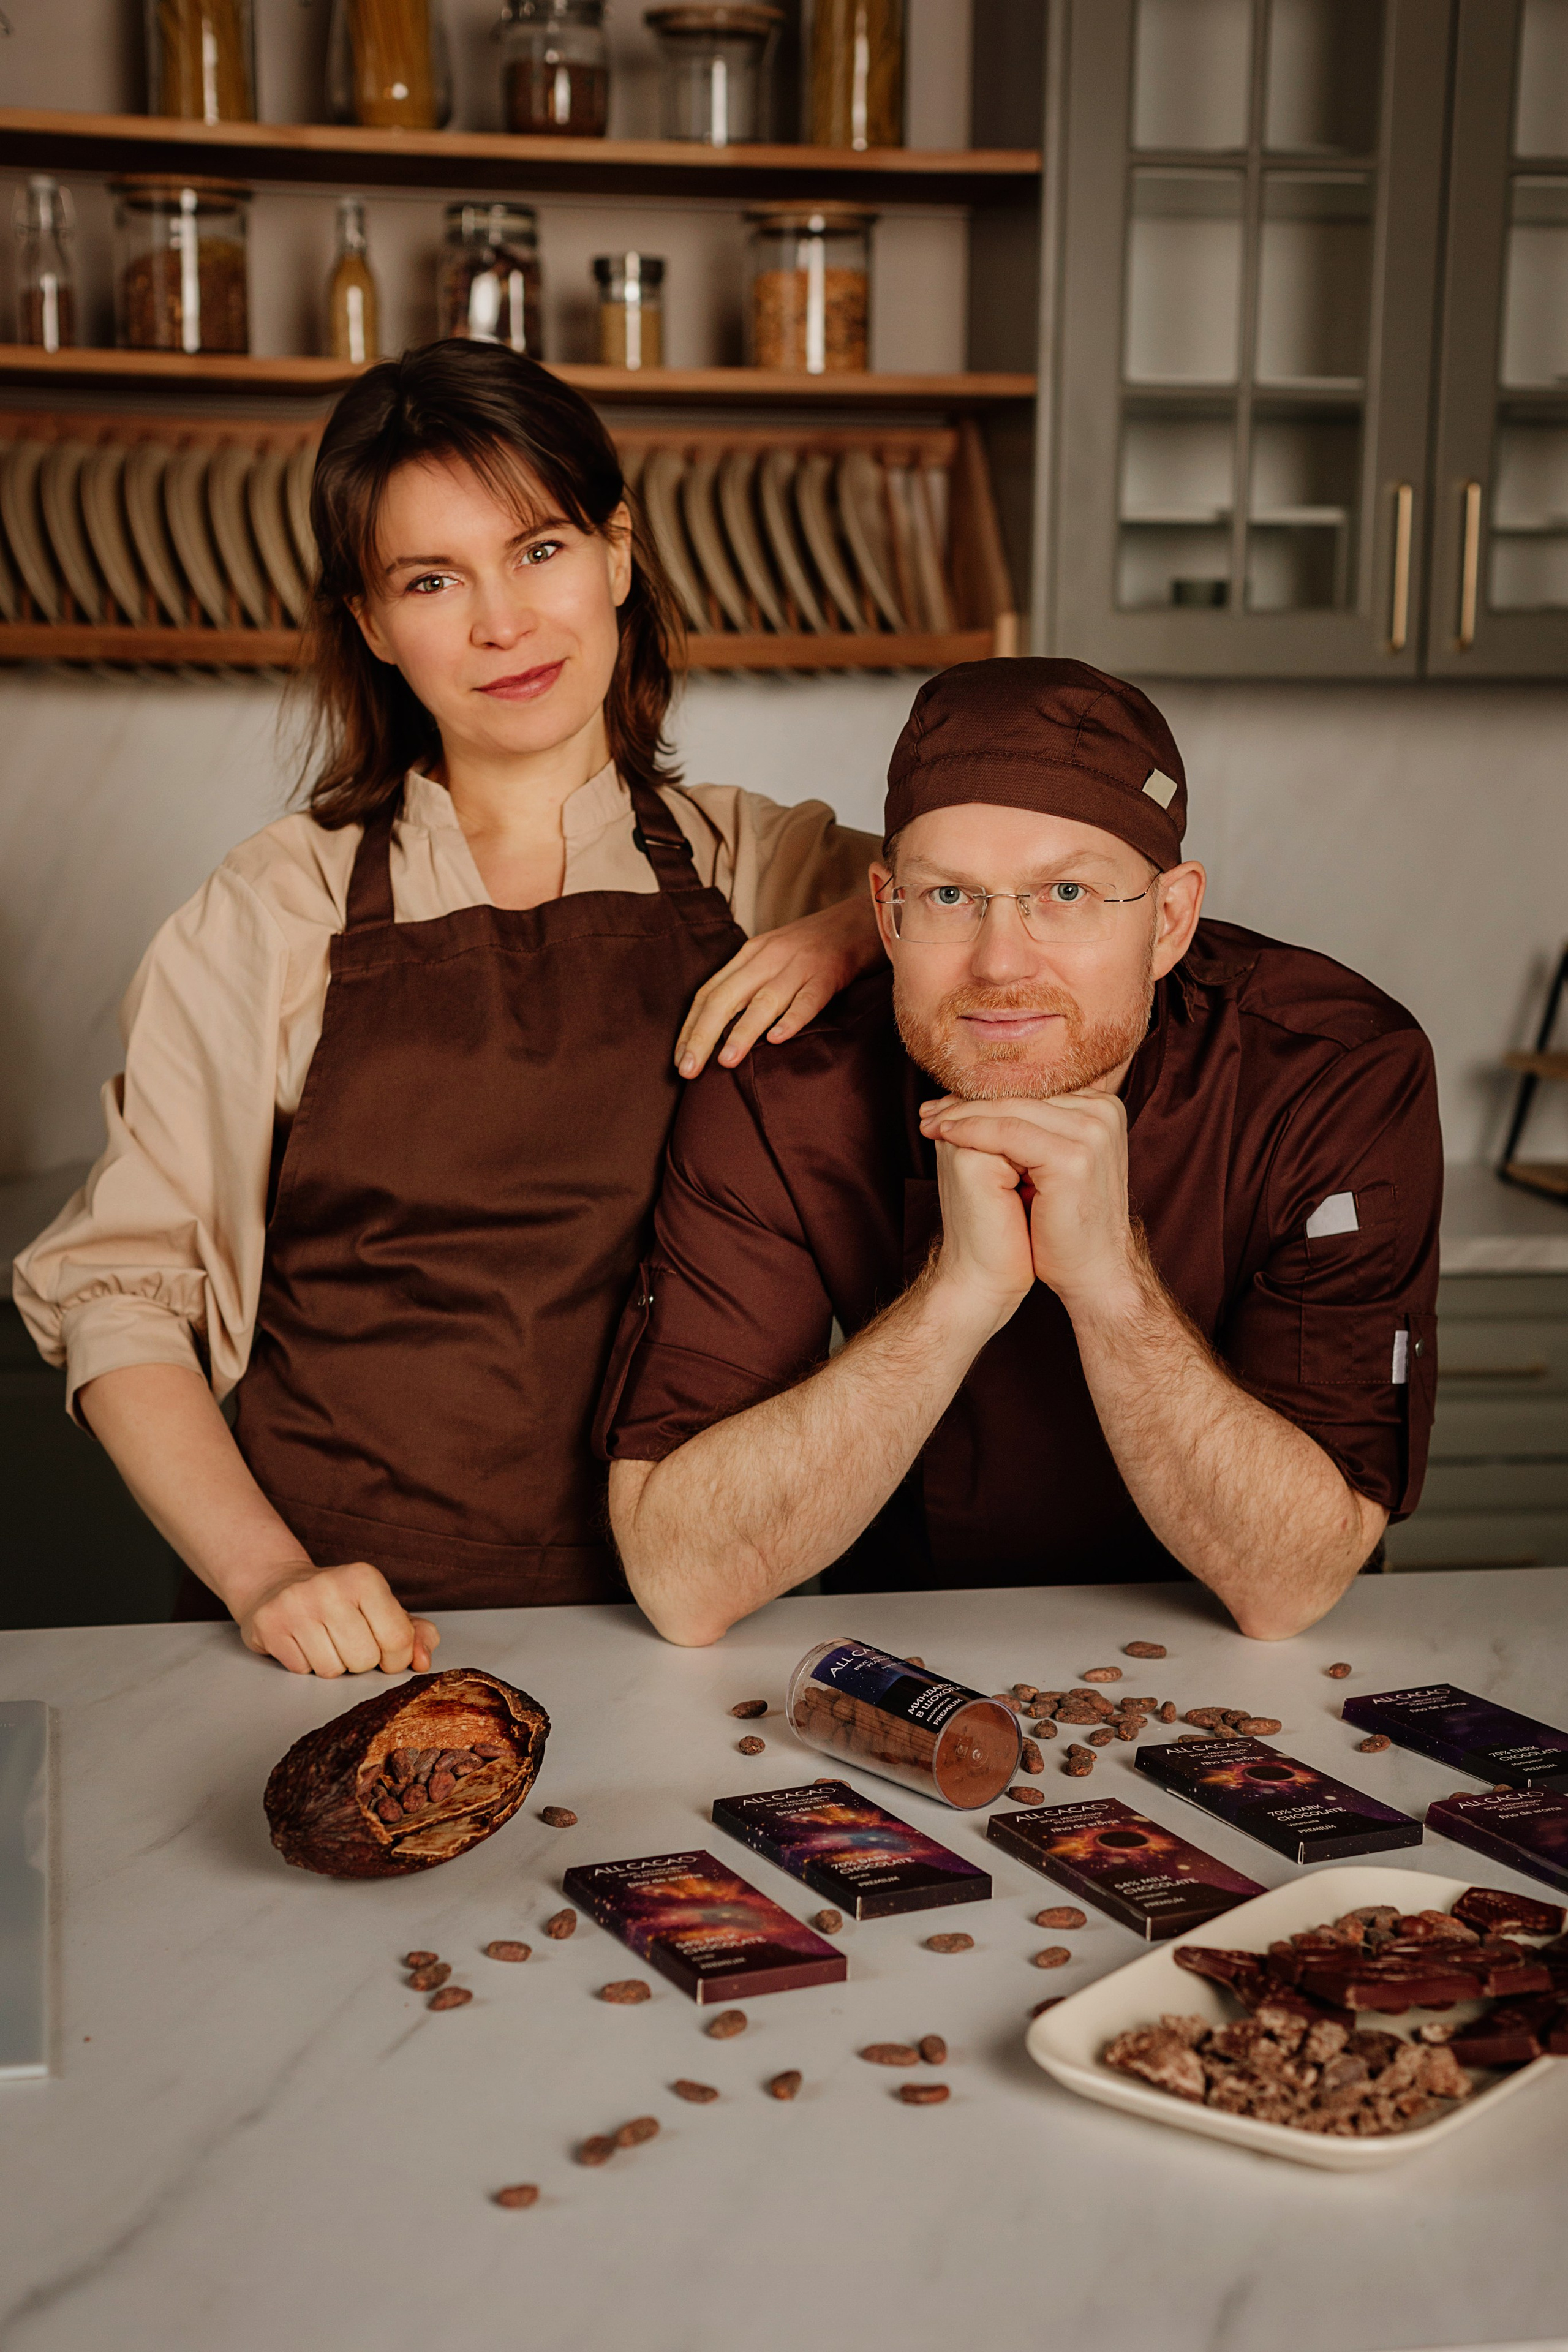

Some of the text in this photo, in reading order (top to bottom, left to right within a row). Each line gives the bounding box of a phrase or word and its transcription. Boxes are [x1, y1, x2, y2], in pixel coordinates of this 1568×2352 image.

[829, 1656, 854, 1678] ALL
[908, 1683, 952, 1715] МИНДАЛЬ
[1396, 1689, 1450, 1700] CACAO
[926, 1697, 951, 1722] MADAGASCAR
[933, 1698, 963, 1725] PREMIUM
[1192, 1741, 1252, 1751] CACAO
[1499, 1748, 1562, 1761] CHOCOLATE
[1523, 1763, 1558, 1772] PREMIUM
[743, 1787, 836, 1806] ALL CACAO
[1458, 1791, 1544, 1809] ALL CACAO
[1016, 1803, 1109, 1822] ALL CACAO
[1277, 1807, 1347, 1822] CHOCOLATE
[1291, 1804, 1324, 1813] DARK
[1297, 1825, 1337, 1834] PREMIUM
[594, 1865, 625, 1877] ALL
[626, 1856, 697, 1869] CACAO
[831, 1861, 857, 1870] 70%
[839, 1856, 916, 1874] CHOCOLATE
[858, 1875, 900, 1888] PREMIUM
[1123, 1877, 1199, 1895] CHOCOLATE
[1140, 1874, 1172, 1884] MILK
[1143, 1897, 1186, 1909] PREMIUM
[683, 1936, 767, 1956] CHOCOLATE
